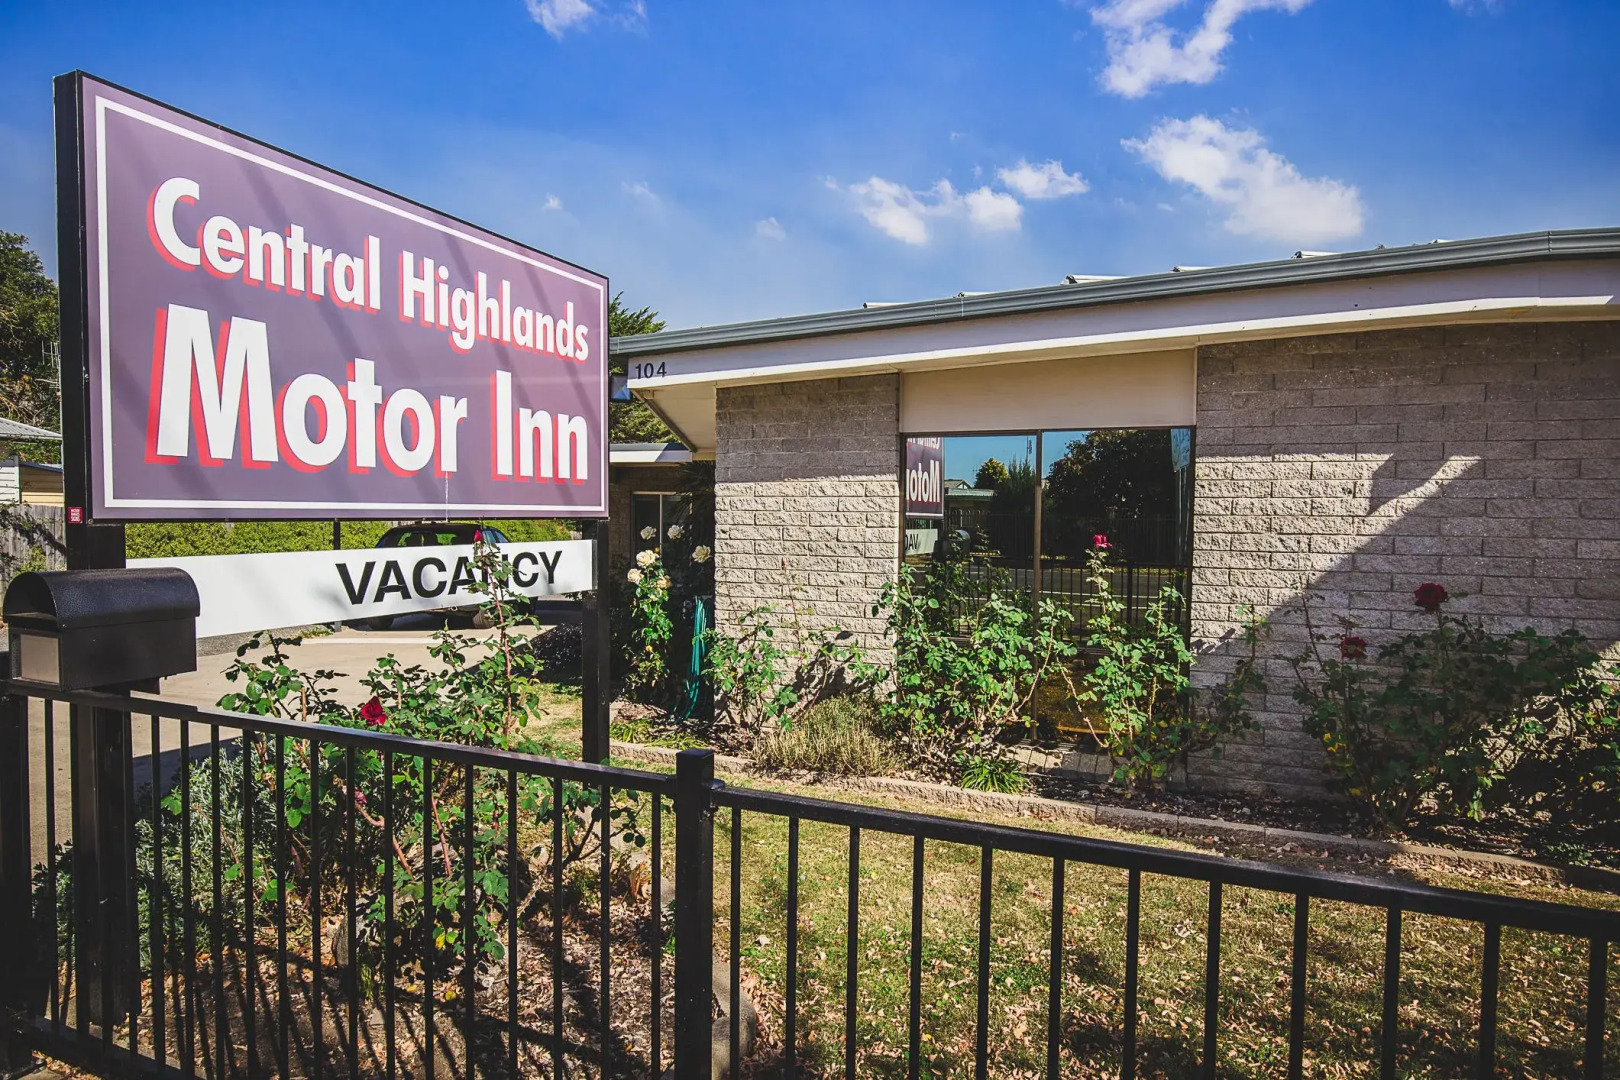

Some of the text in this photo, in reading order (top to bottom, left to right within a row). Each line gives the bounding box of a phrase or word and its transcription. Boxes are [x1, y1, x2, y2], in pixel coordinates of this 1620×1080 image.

[148, 177, 589, 364] Central Highlands
[146, 303, 588, 482] Motor Inn
[635, 361, 667, 379] 104
